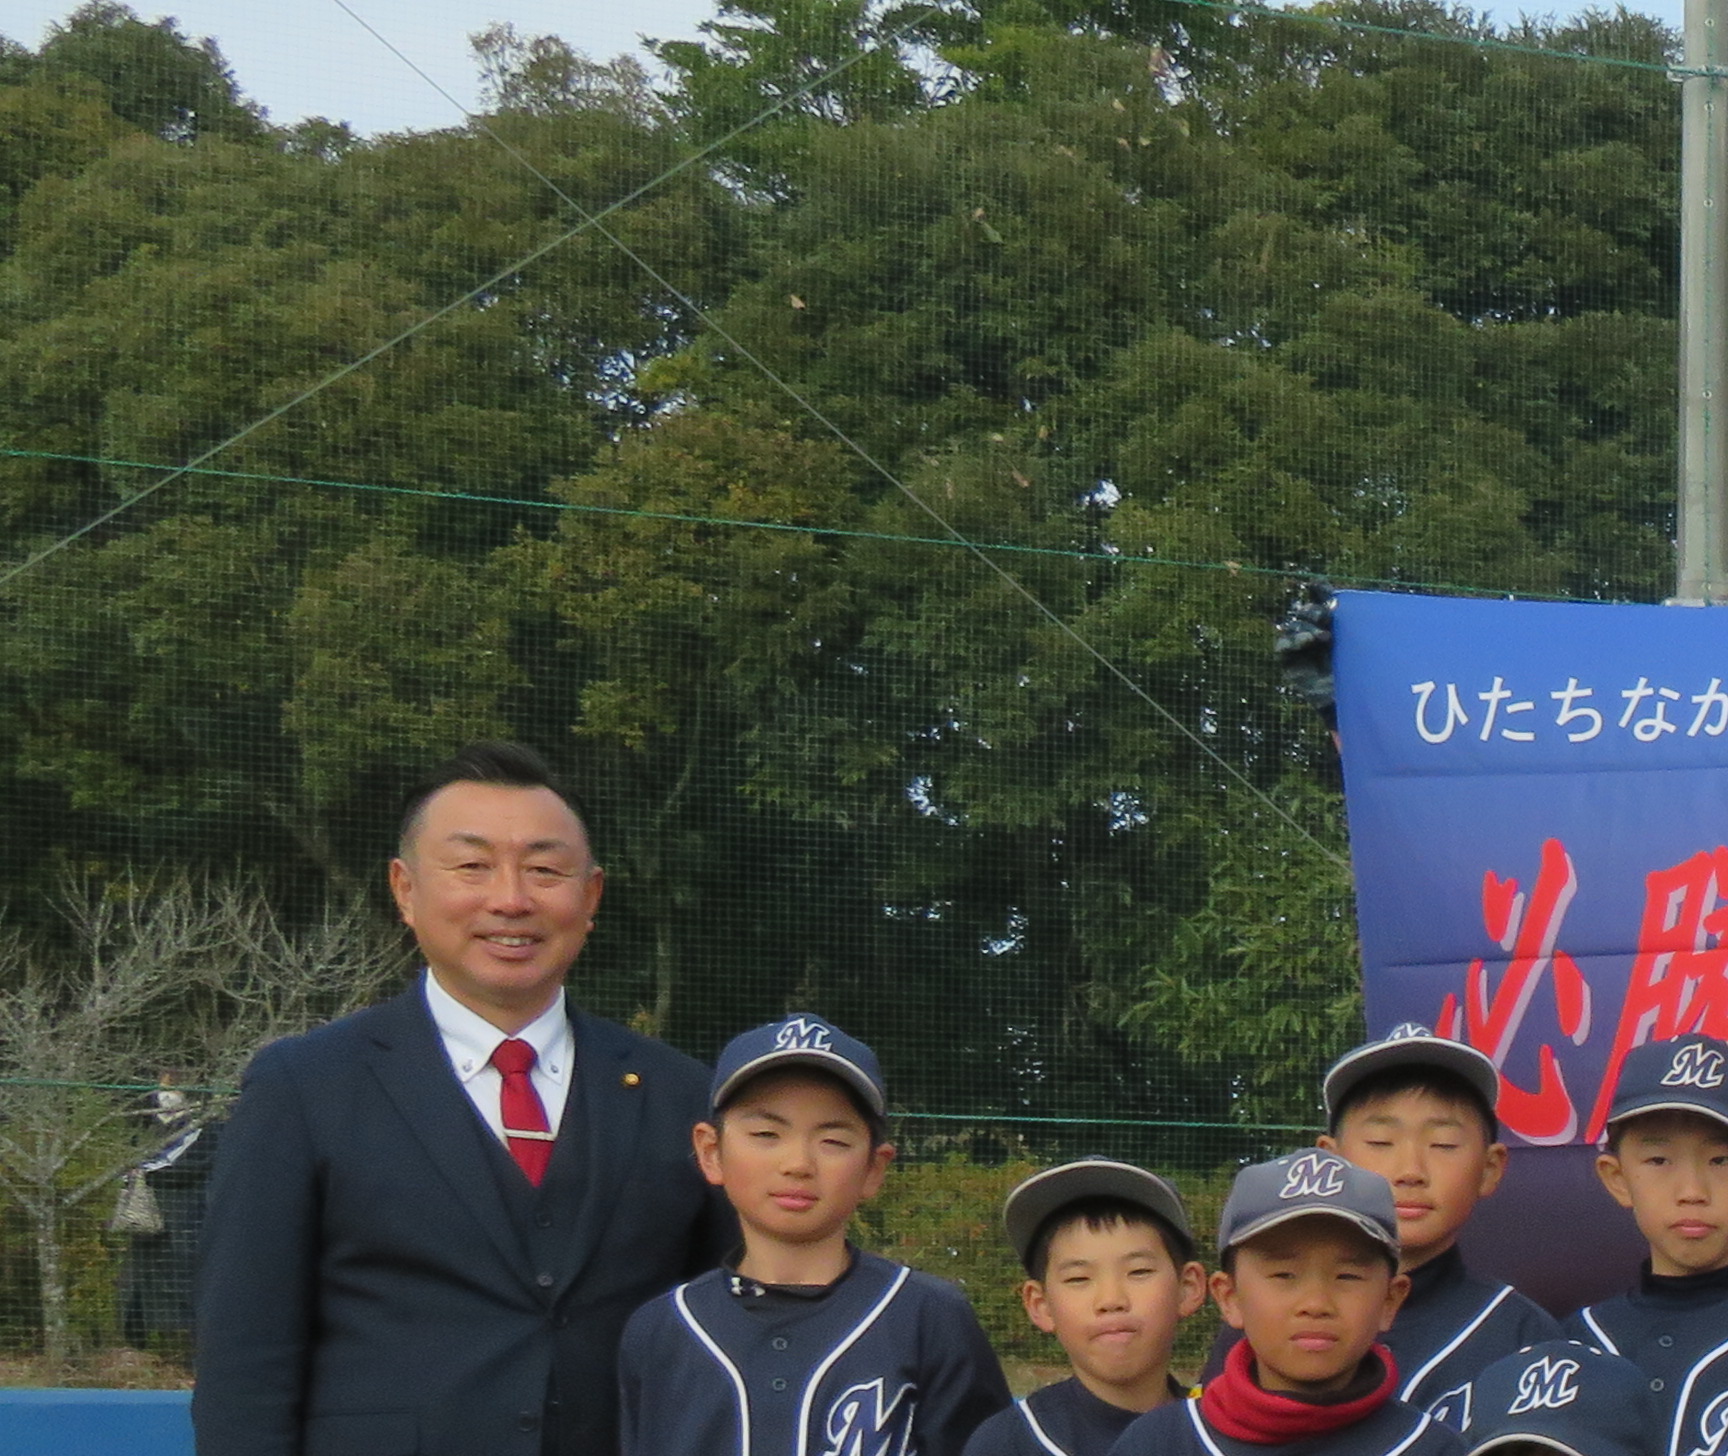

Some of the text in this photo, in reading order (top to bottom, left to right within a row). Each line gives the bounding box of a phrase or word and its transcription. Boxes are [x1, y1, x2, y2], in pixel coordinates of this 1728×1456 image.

[773, 1018, 832, 1051] M
[1661, 1043, 1726, 1089] M
[1279, 1153, 1346, 1200] M
[1508, 1357, 1580, 1415] M
